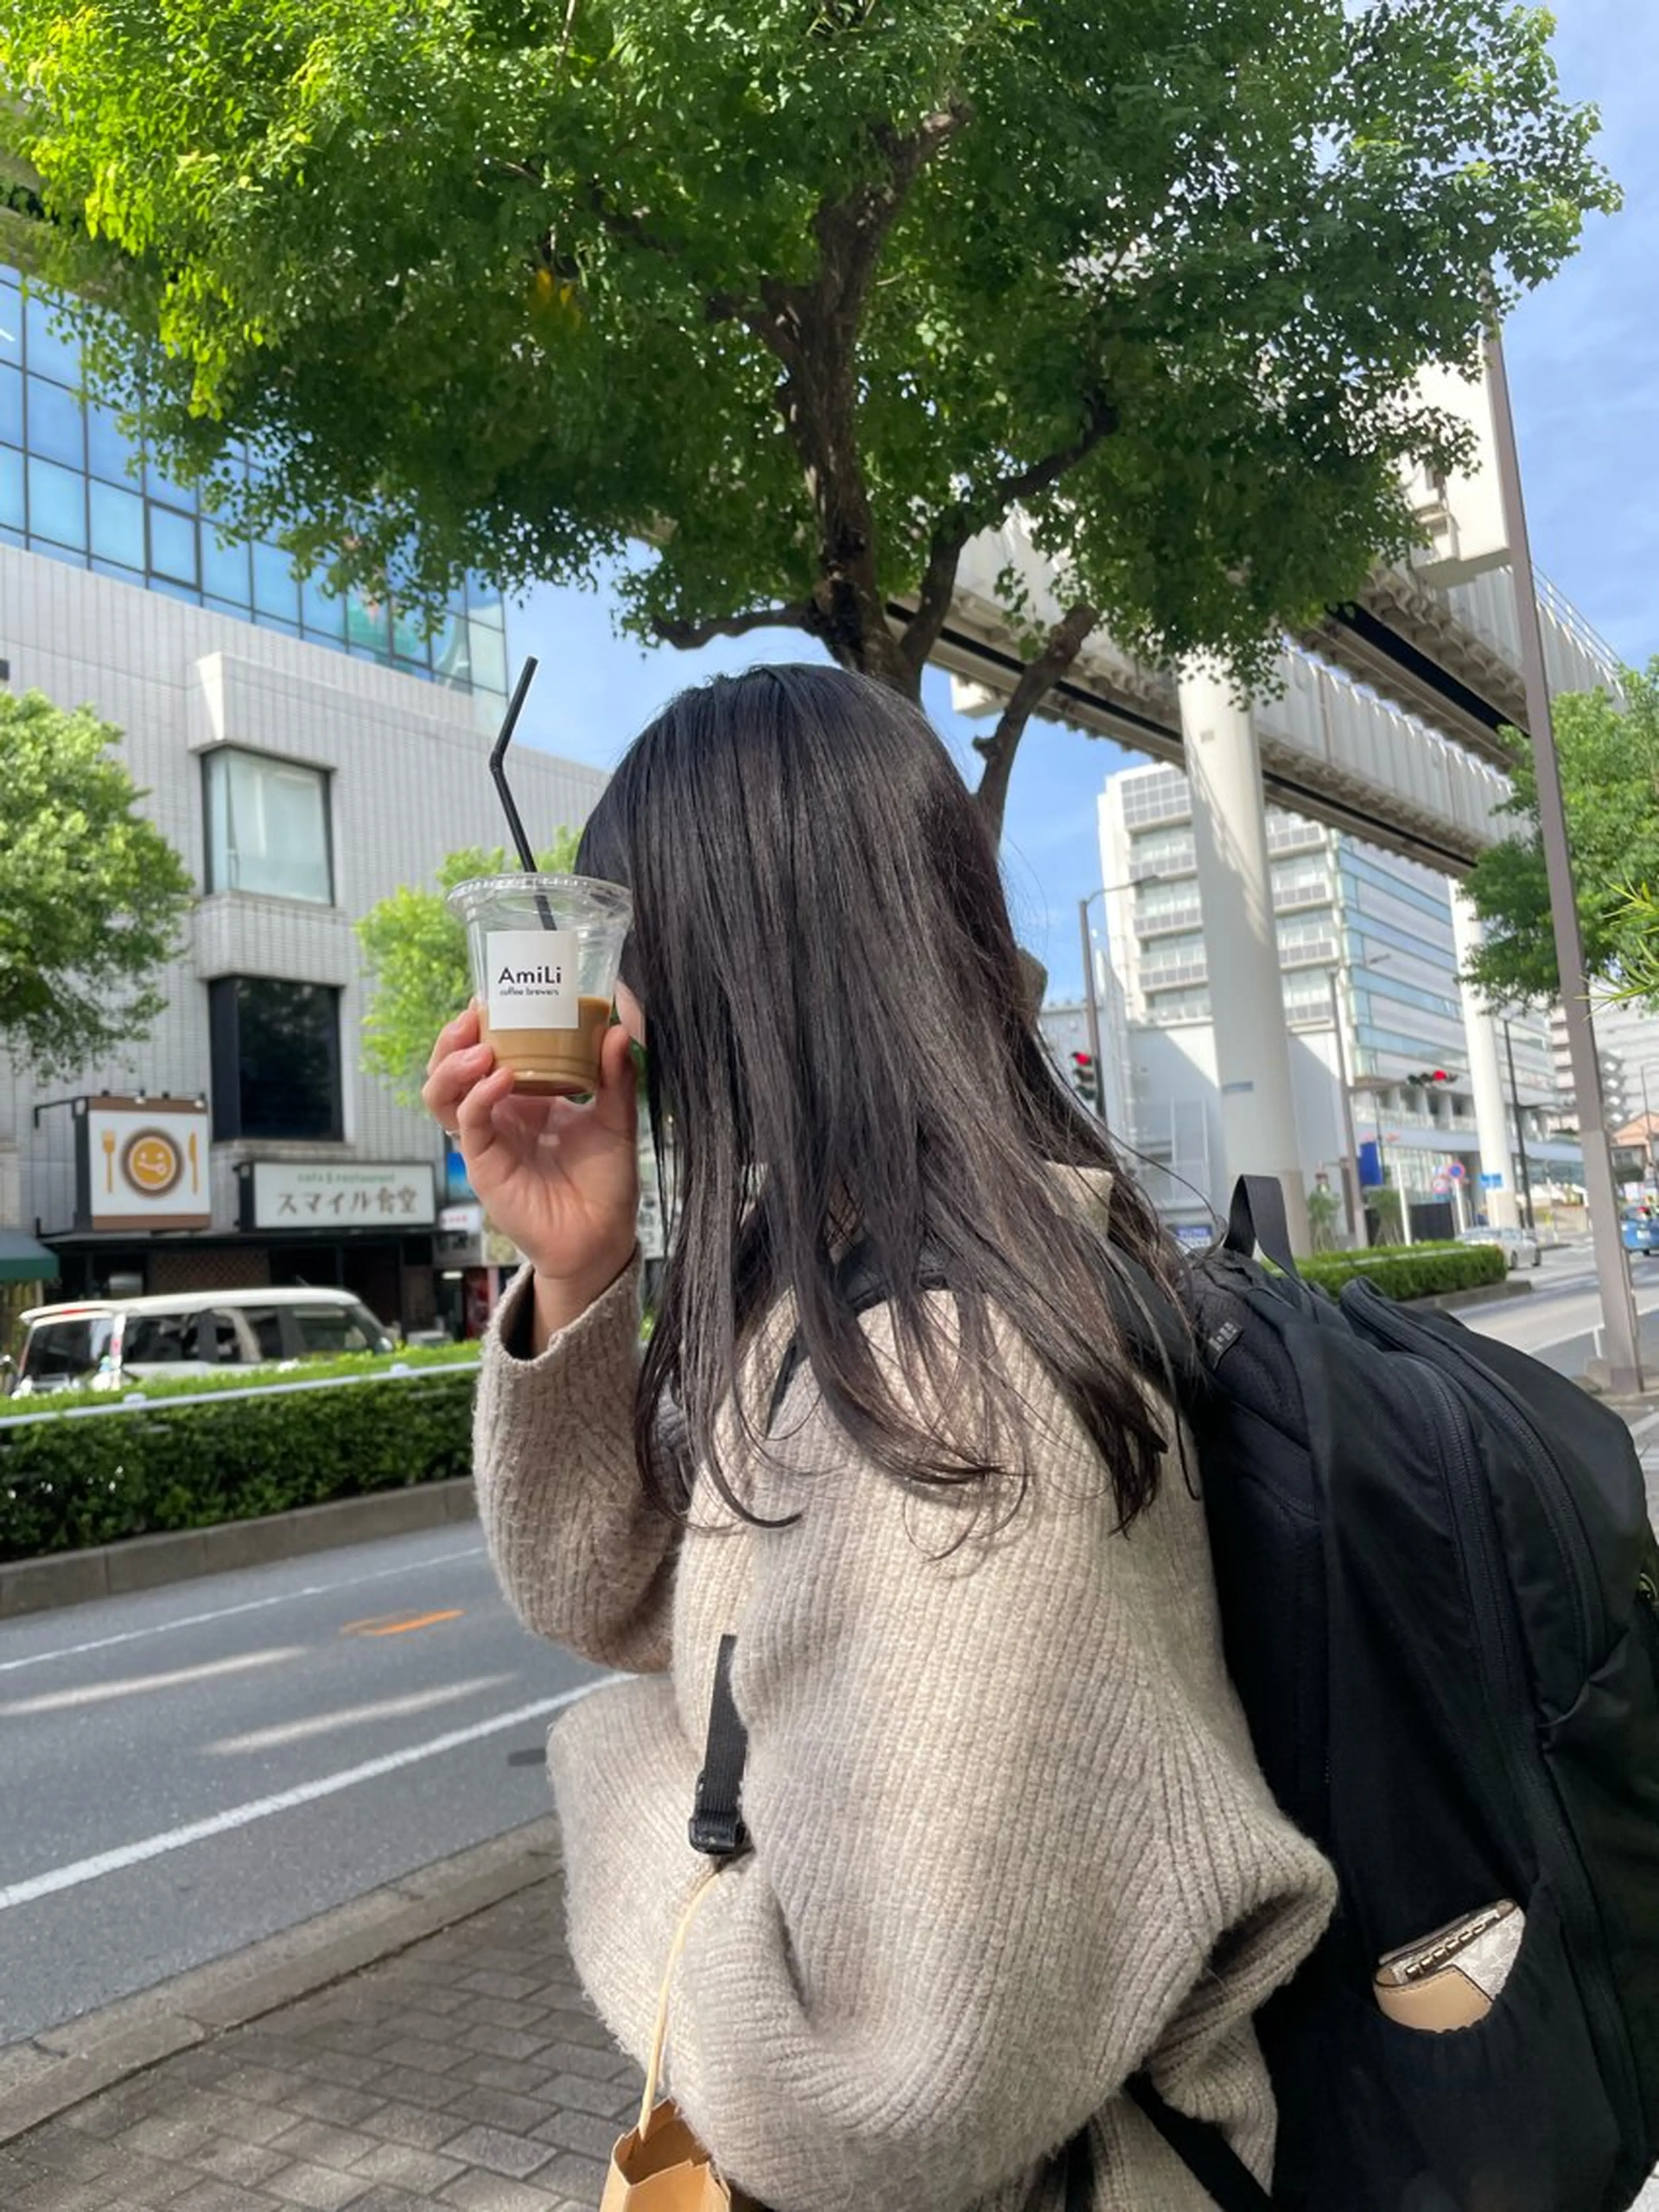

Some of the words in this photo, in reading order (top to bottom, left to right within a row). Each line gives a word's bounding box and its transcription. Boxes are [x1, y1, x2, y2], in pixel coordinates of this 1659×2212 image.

[498, 966, 561, 984] AmiLi
[500, 986, 524, 996] coffee
[277, 1185, 417, 1214] スマイル食堂
